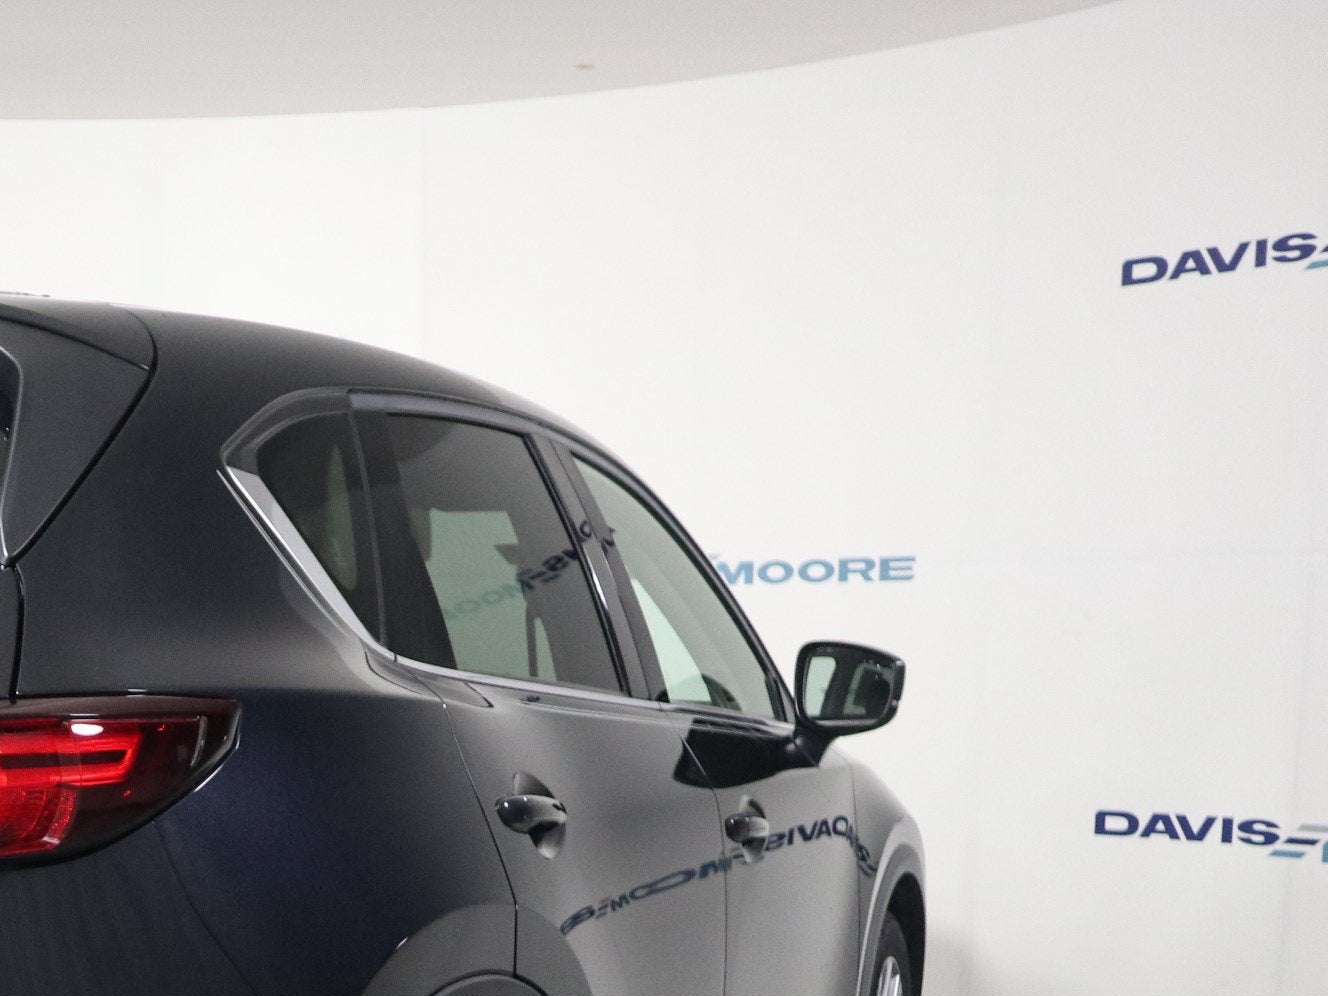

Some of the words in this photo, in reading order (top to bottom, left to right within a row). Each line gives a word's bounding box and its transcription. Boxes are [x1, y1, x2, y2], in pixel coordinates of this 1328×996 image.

[1121, 232, 1317, 286] DAVIS
[717, 556, 916, 585] MOORE
[1094, 810, 1280, 846] DAVIS
